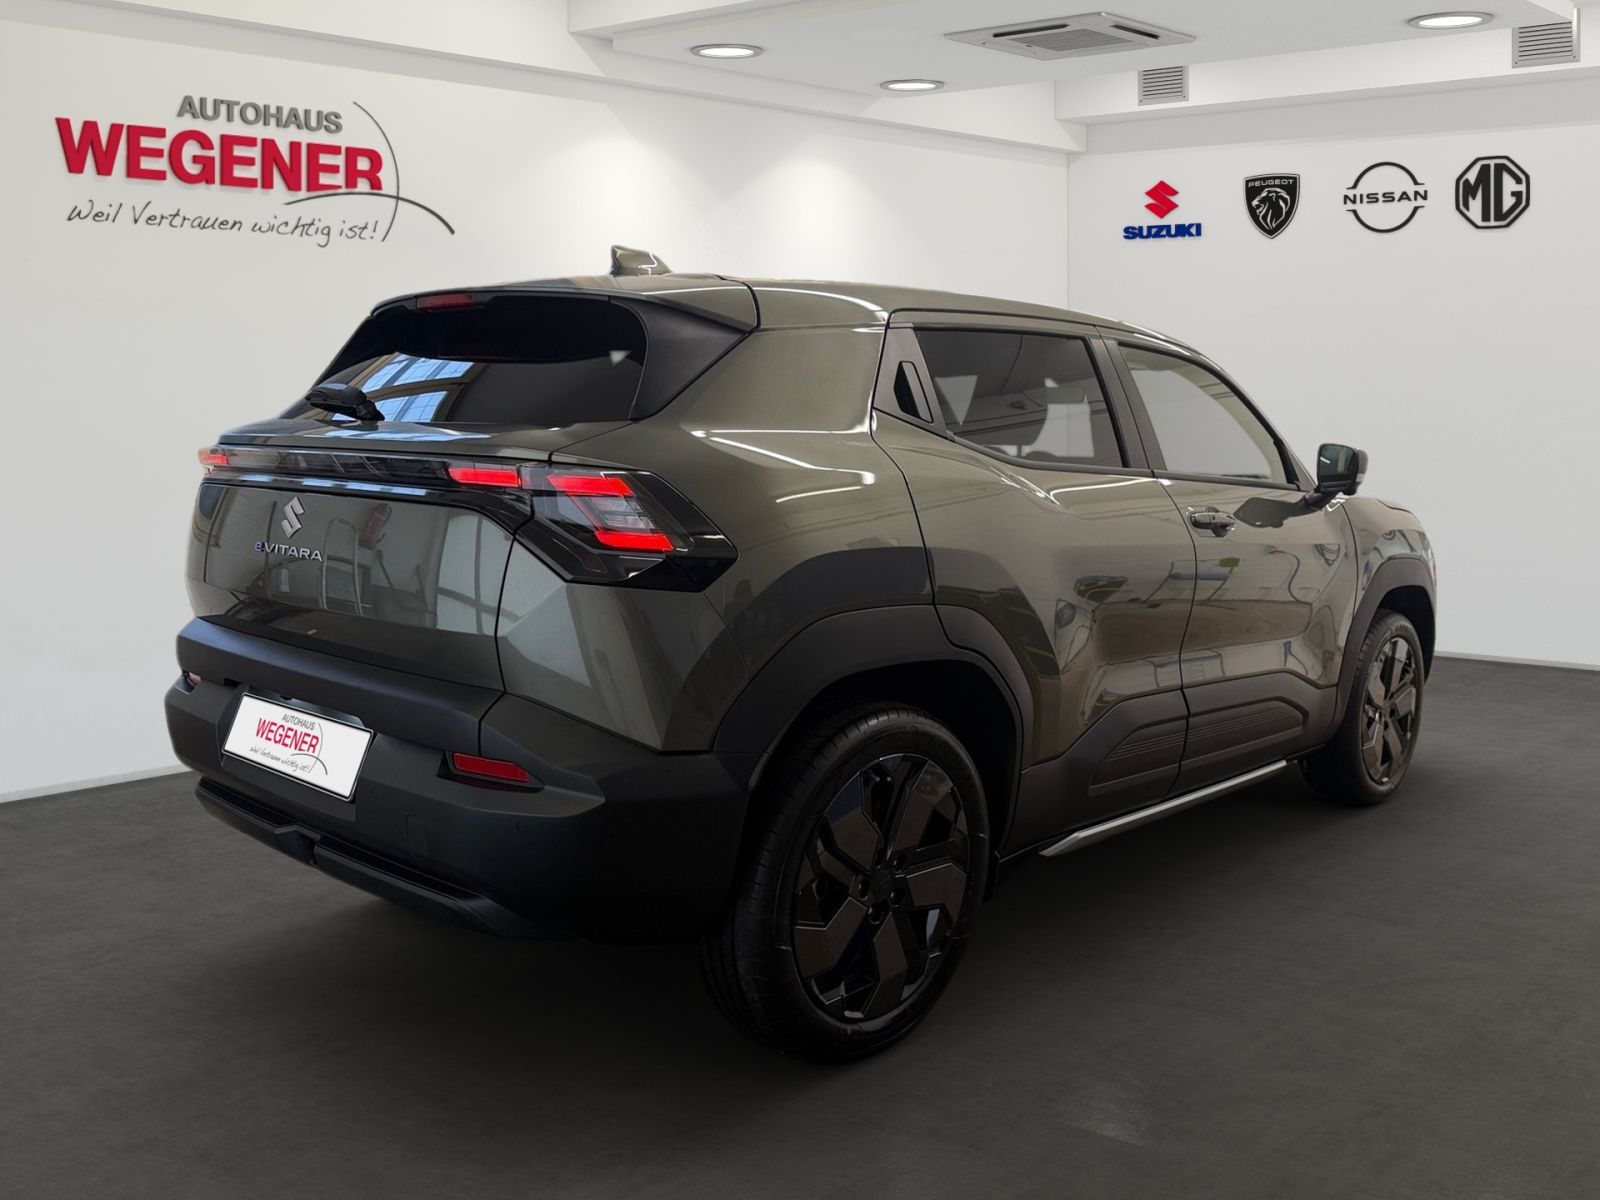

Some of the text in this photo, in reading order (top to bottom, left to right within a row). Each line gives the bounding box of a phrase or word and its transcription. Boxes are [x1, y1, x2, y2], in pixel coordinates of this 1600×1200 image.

[176, 95, 342, 134] AUTOHAUS
[55, 117, 383, 192] WEGENER
[1248, 178, 1295, 188] PEUGEOT
[1343, 189, 1428, 206] NISSAN
[1462, 163, 1523, 222] MG
[67, 199, 378, 248] Weil Vertrauen wichtig ist!
[1122, 222, 1202, 241] SUZUKI
[256, 718, 319, 753] WEGENER
[282, 714, 315, 730] AUTOHAUS
